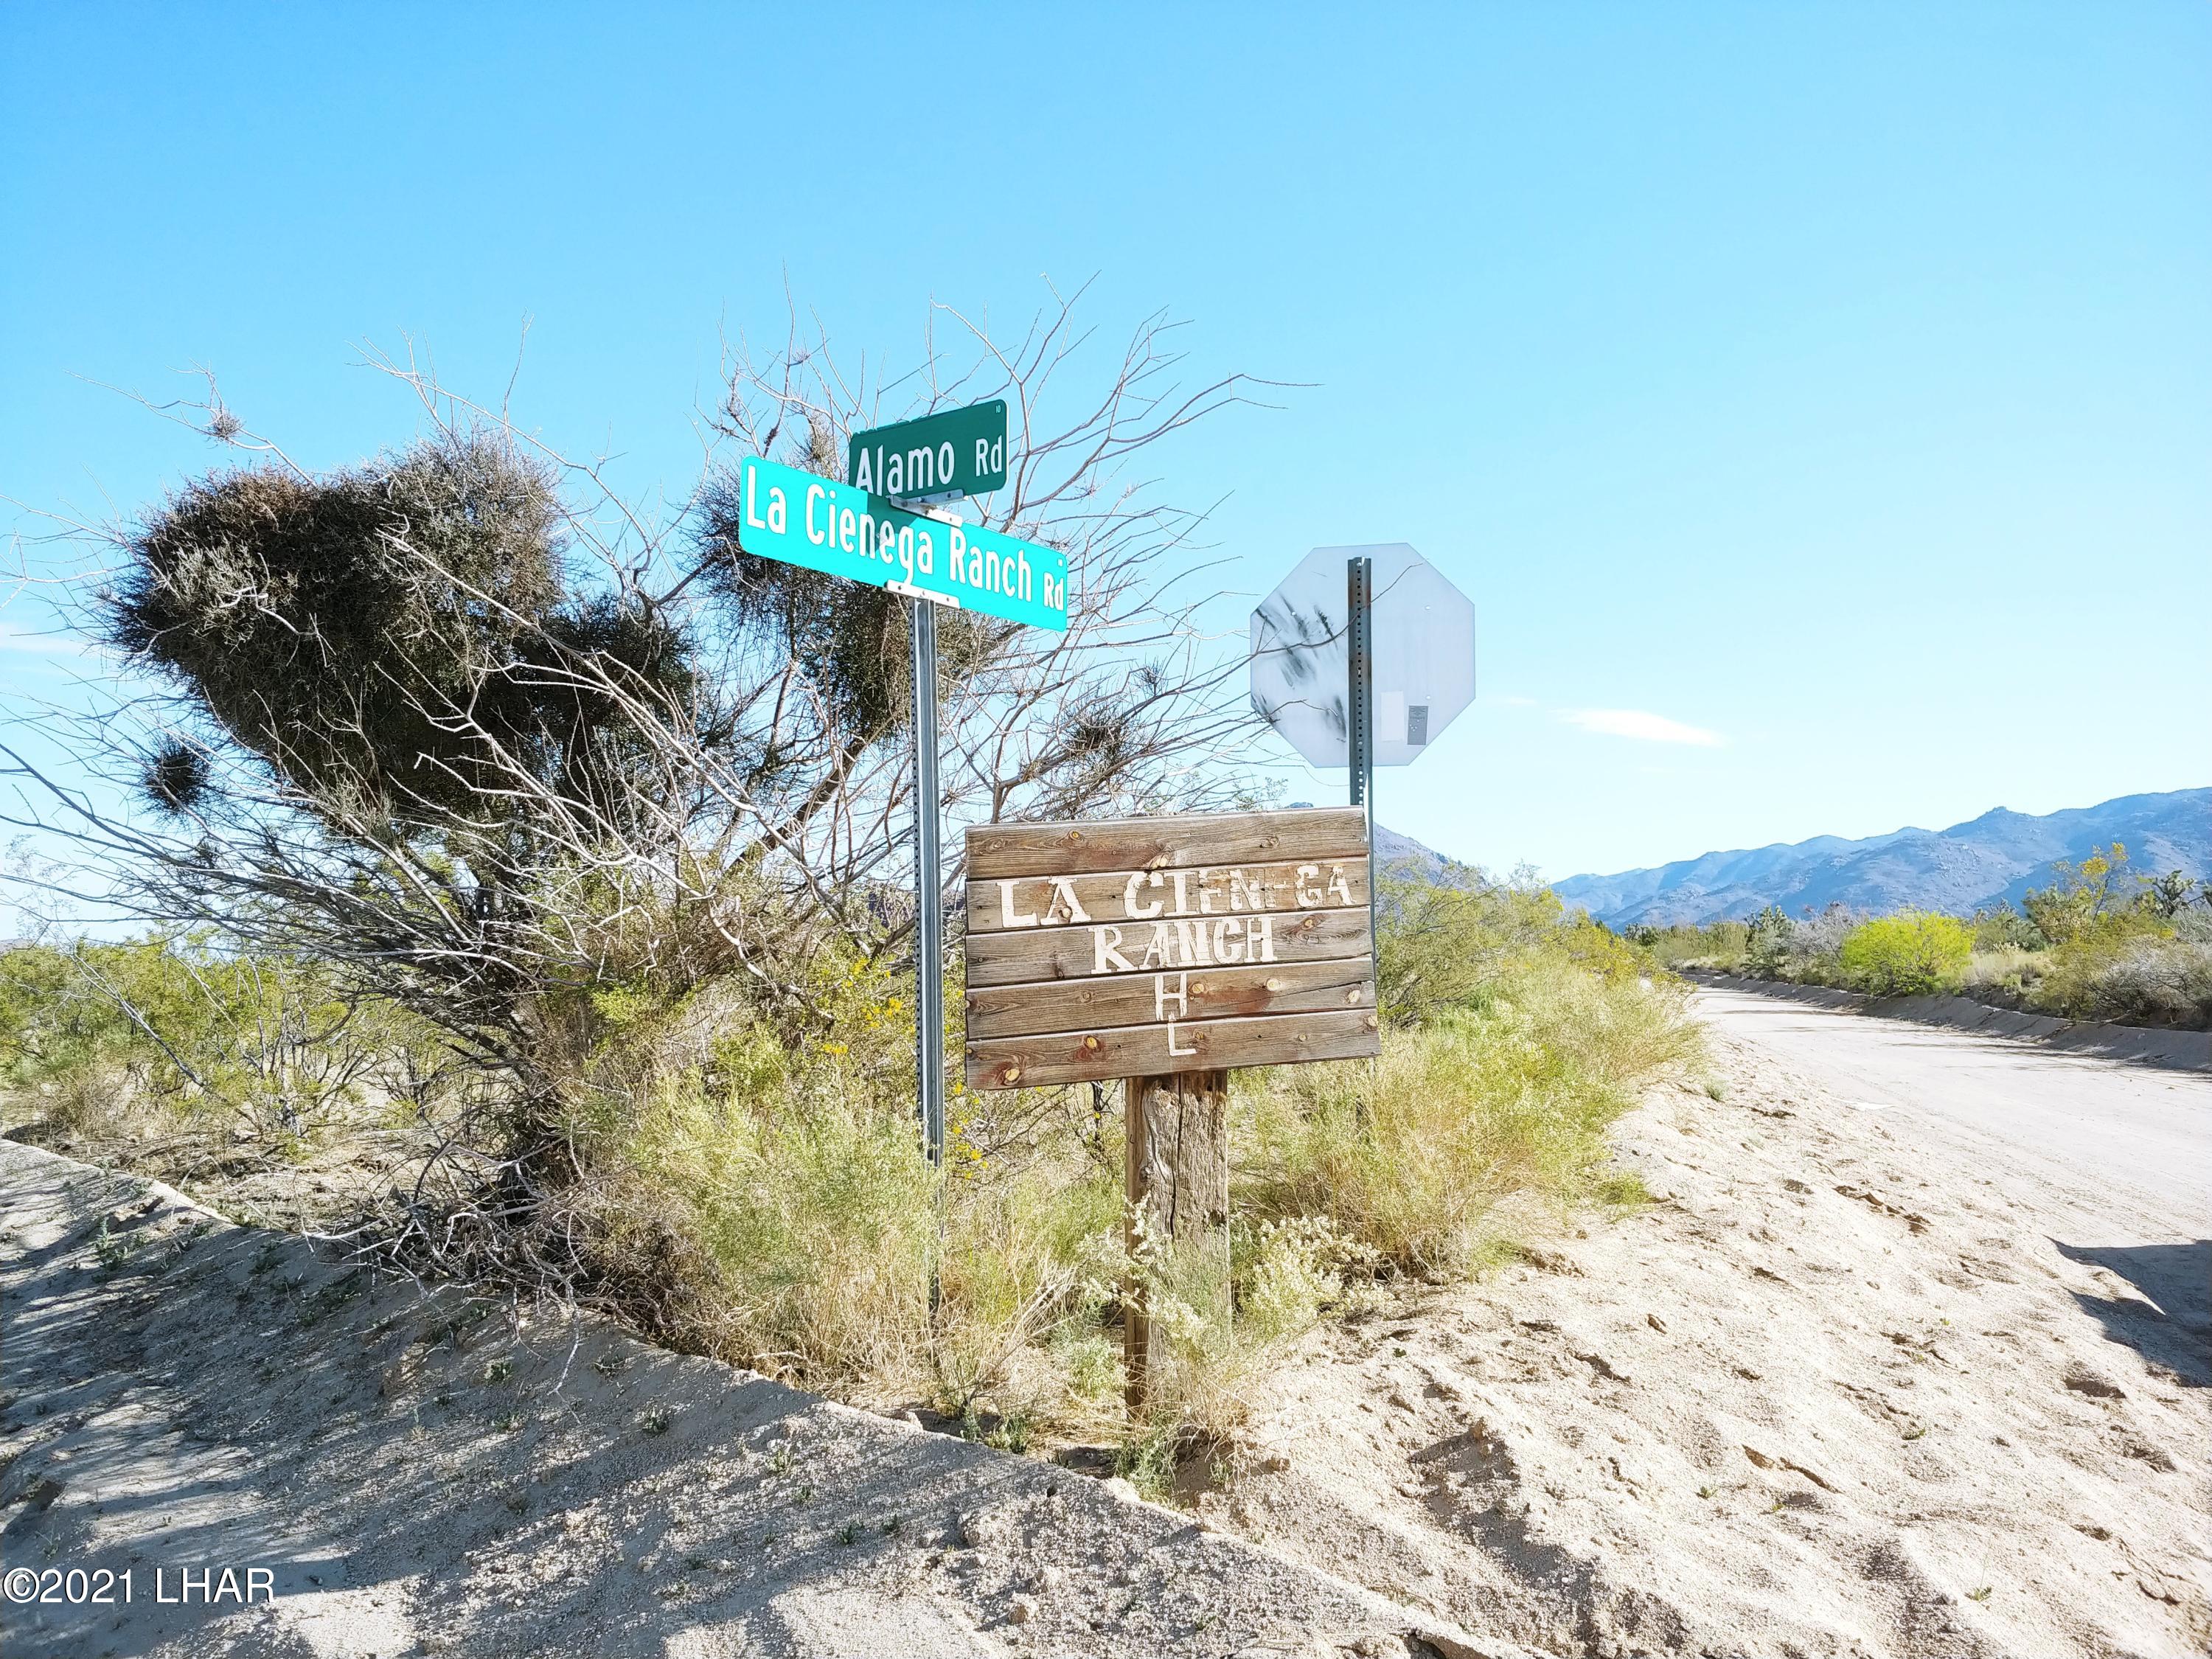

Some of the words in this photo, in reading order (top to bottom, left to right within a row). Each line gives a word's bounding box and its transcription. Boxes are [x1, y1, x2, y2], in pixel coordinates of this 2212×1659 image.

[855, 441, 955, 497] Alamo
[975, 435, 1003, 477] Rd
[747, 465, 787, 535] La
[806, 483, 934, 585] Cienega
[949, 526, 1032, 602] Ranch
[1043, 571, 1064, 611] Rd
[997, 875, 1091, 928] LA
[1088, 916, 1278, 975] RANCH
[1154, 972, 1188, 1021] H
[1167, 1012, 1197, 1057] L
